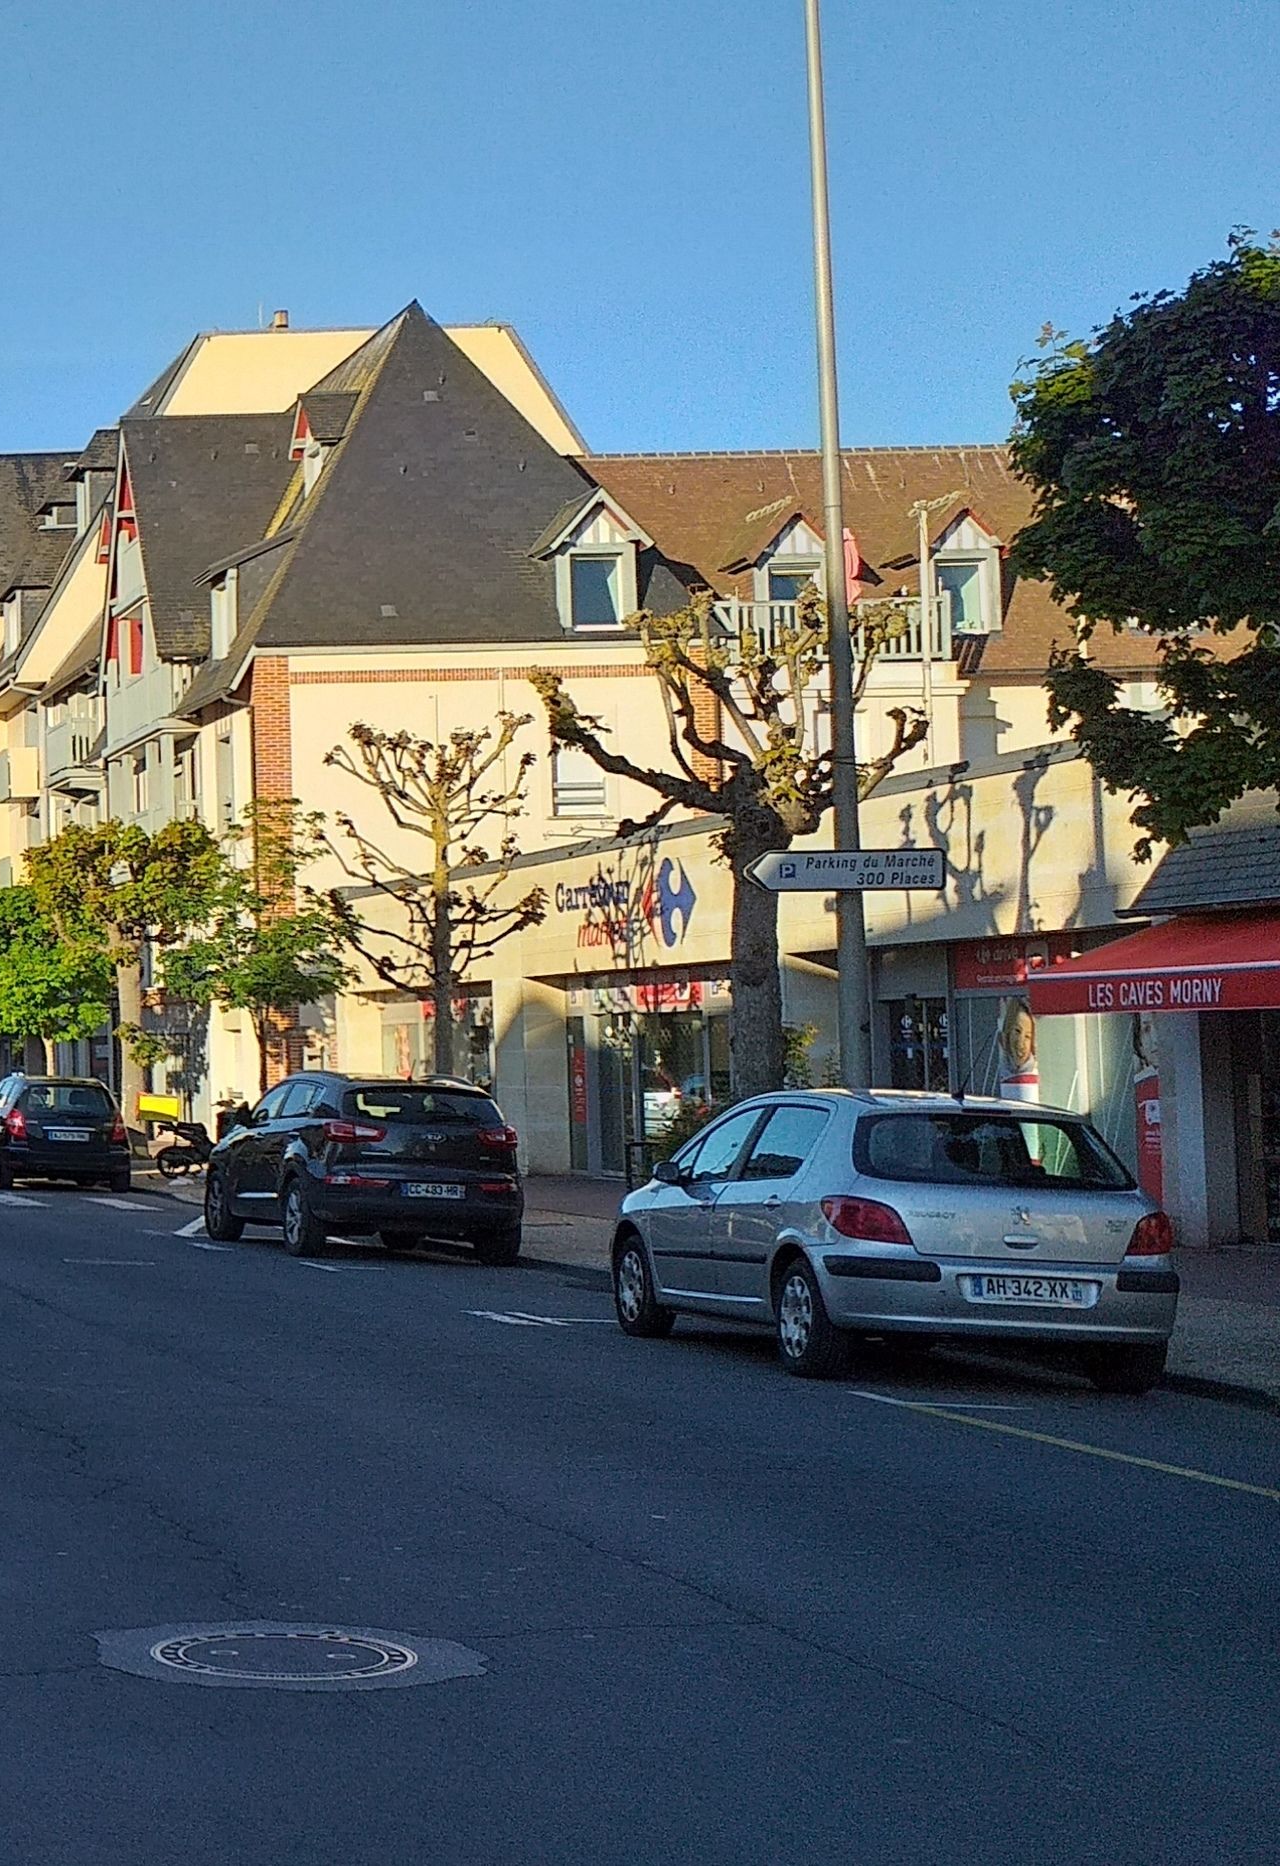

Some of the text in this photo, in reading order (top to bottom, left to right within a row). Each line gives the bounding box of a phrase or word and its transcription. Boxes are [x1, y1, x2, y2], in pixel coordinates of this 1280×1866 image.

[806, 854, 935, 871] Parking du Marché
[856, 871, 935, 885] 300 Places
[1089, 978, 1223, 1008] LES CAVES MORNY
[986, 1278, 1069, 1299] AH-342-XX
